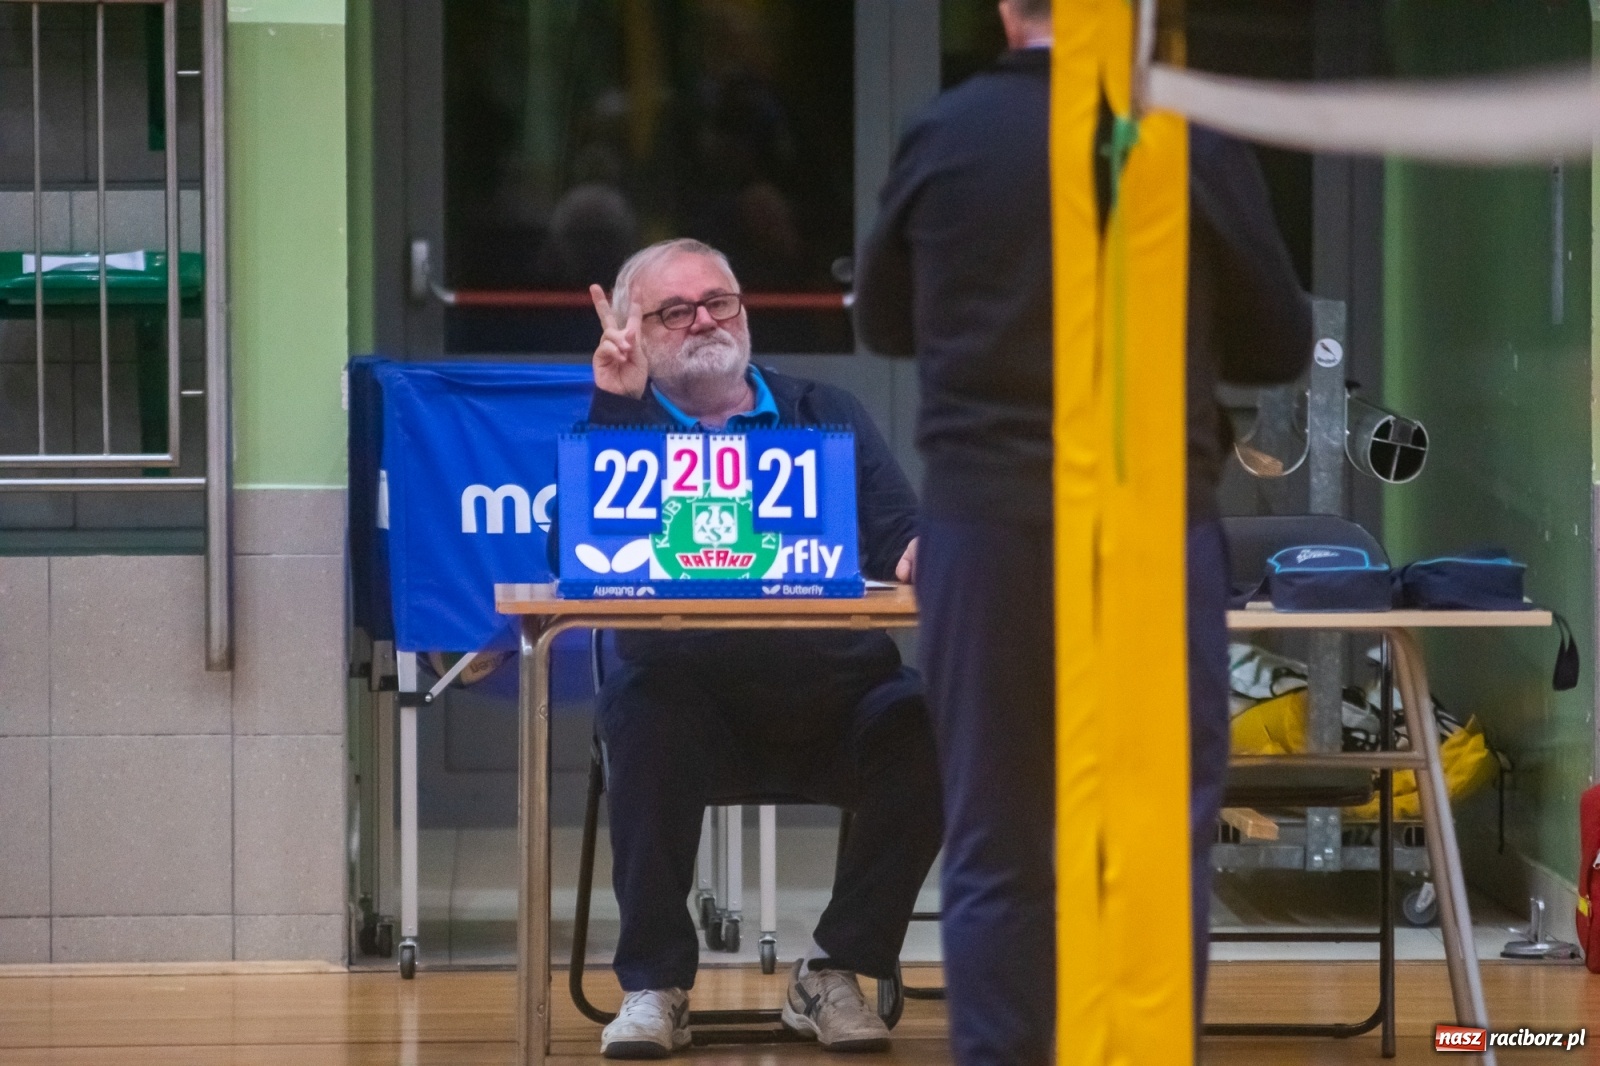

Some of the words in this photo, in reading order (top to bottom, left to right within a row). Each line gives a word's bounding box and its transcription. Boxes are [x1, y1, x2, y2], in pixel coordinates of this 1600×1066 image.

[593, 448, 658, 519] 22
[672, 448, 698, 492] 2
[716, 446, 741, 490] 0
[758, 448, 817, 518] 21
[655, 500, 682, 549] KLUB
[678, 550, 754, 568] RAFAKO
[593, 584, 634, 596] Butterfly
[782, 584, 824, 596] Butterfly
